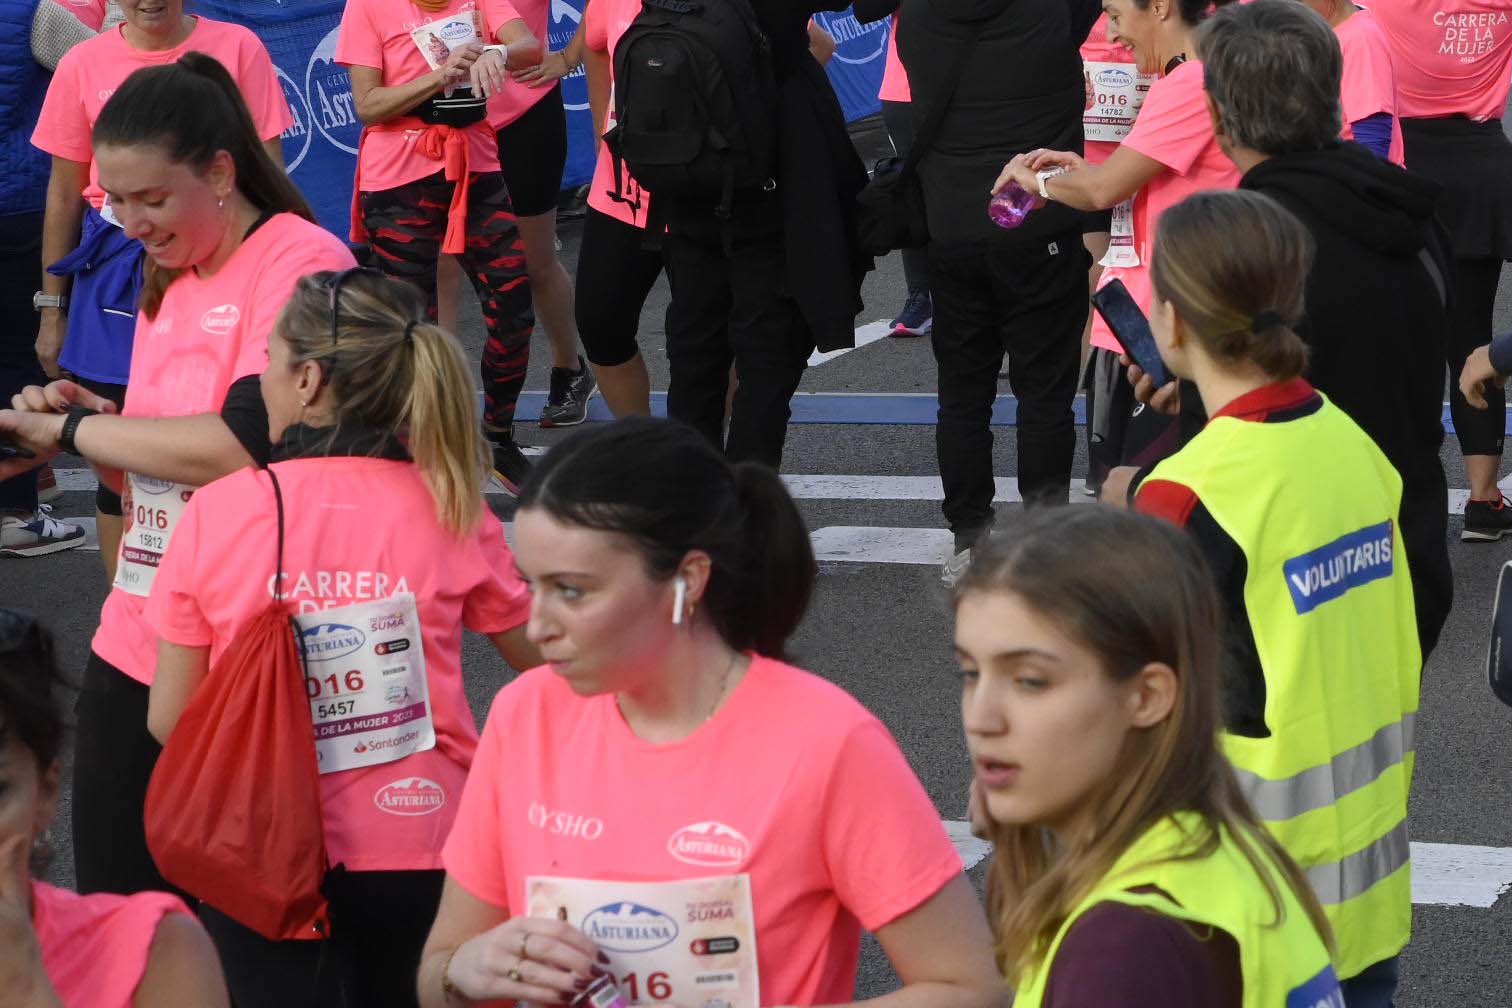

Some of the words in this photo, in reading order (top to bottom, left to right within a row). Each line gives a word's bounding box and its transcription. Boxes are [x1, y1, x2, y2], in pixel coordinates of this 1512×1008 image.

[1433, 11, 1508, 27] CARRERA
[1445, 28, 1468, 41] DE
[1475, 27, 1493, 41] LA
[1438, 41, 1495, 55] MUJER
[1098, 75, 1130, 84] ASTURIANA
[1098, 94, 1127, 105] 016
[1101, 108, 1123, 116] 14782
[137, 505, 168, 529] 016
[1291, 536, 1392, 597] VOLUNTARIS
[267, 571, 412, 600] CARRERA
[371, 619, 405, 632] SUMA
[307, 670, 364, 698] 016
[319, 701, 355, 719] 5457
[321, 726, 335, 736] DE
[338, 723, 352, 734] LA
[354, 717, 389, 730] MUJER
[368, 730, 420, 752] Santander
[687, 910, 735, 922] SUMA
[590, 920, 671, 941] ASTURIANA
[607, 970, 673, 1001] 16
